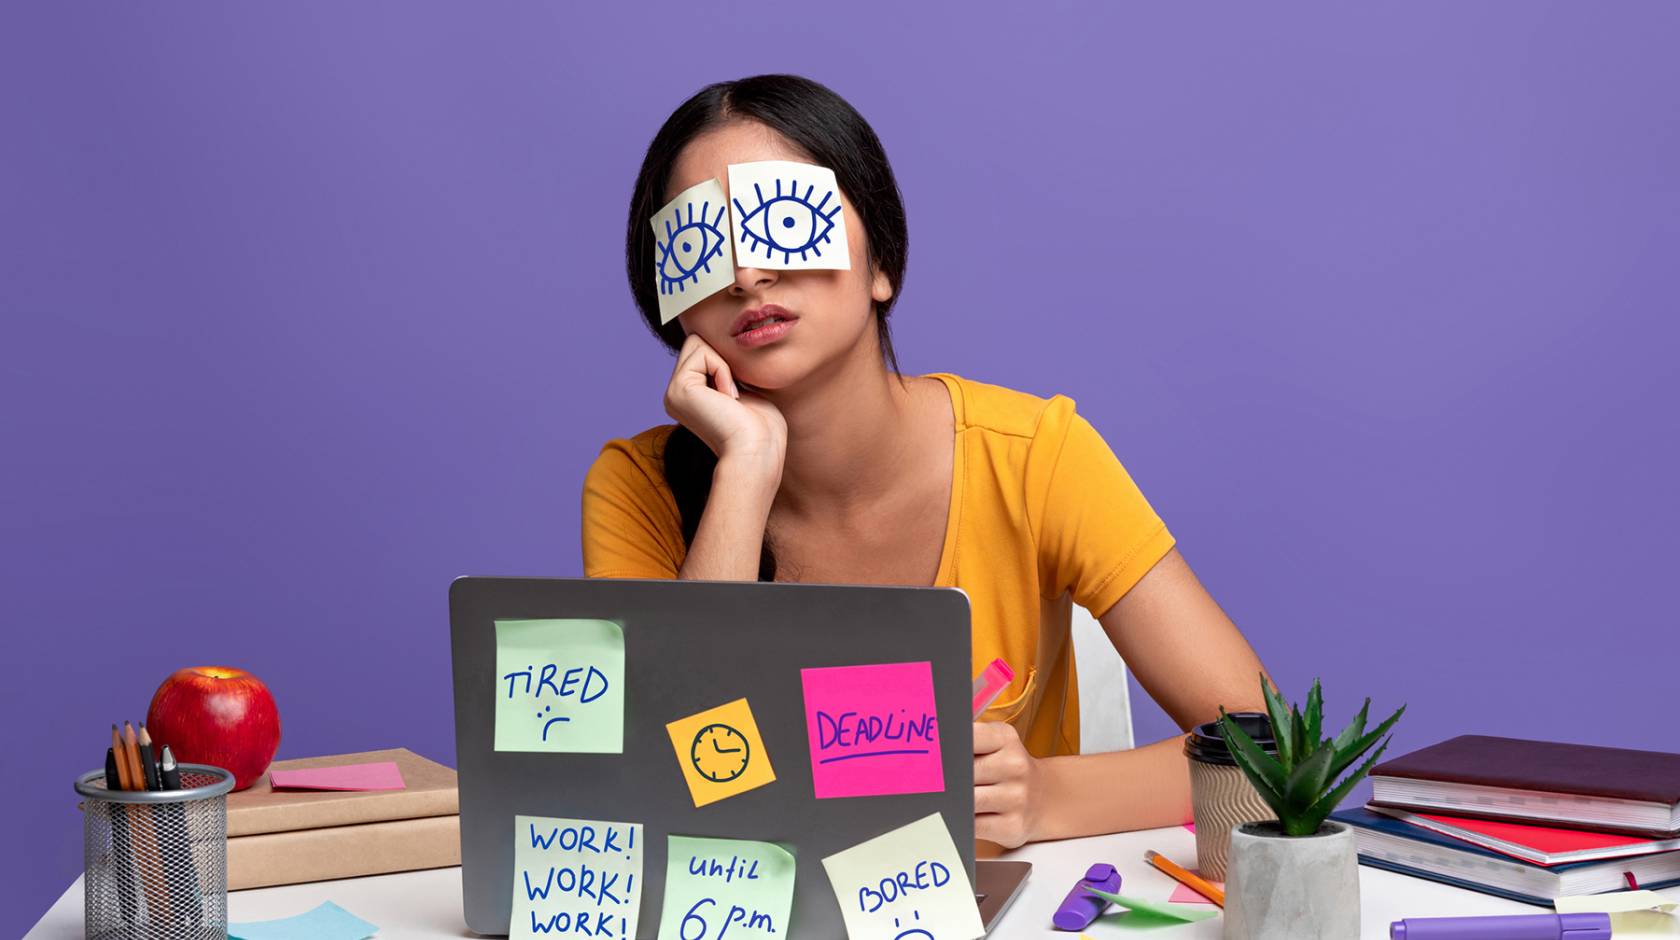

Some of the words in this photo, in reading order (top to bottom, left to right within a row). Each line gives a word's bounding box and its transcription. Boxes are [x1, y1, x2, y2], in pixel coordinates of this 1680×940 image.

[529, 823, 635, 860] WORK!
[523, 863, 634, 907] WORK!
[859, 861, 951, 913] BORED
[530, 910, 627, 940] WORK!
[679, 897, 717, 940] 6
[716, 904, 776, 940] p.m.
